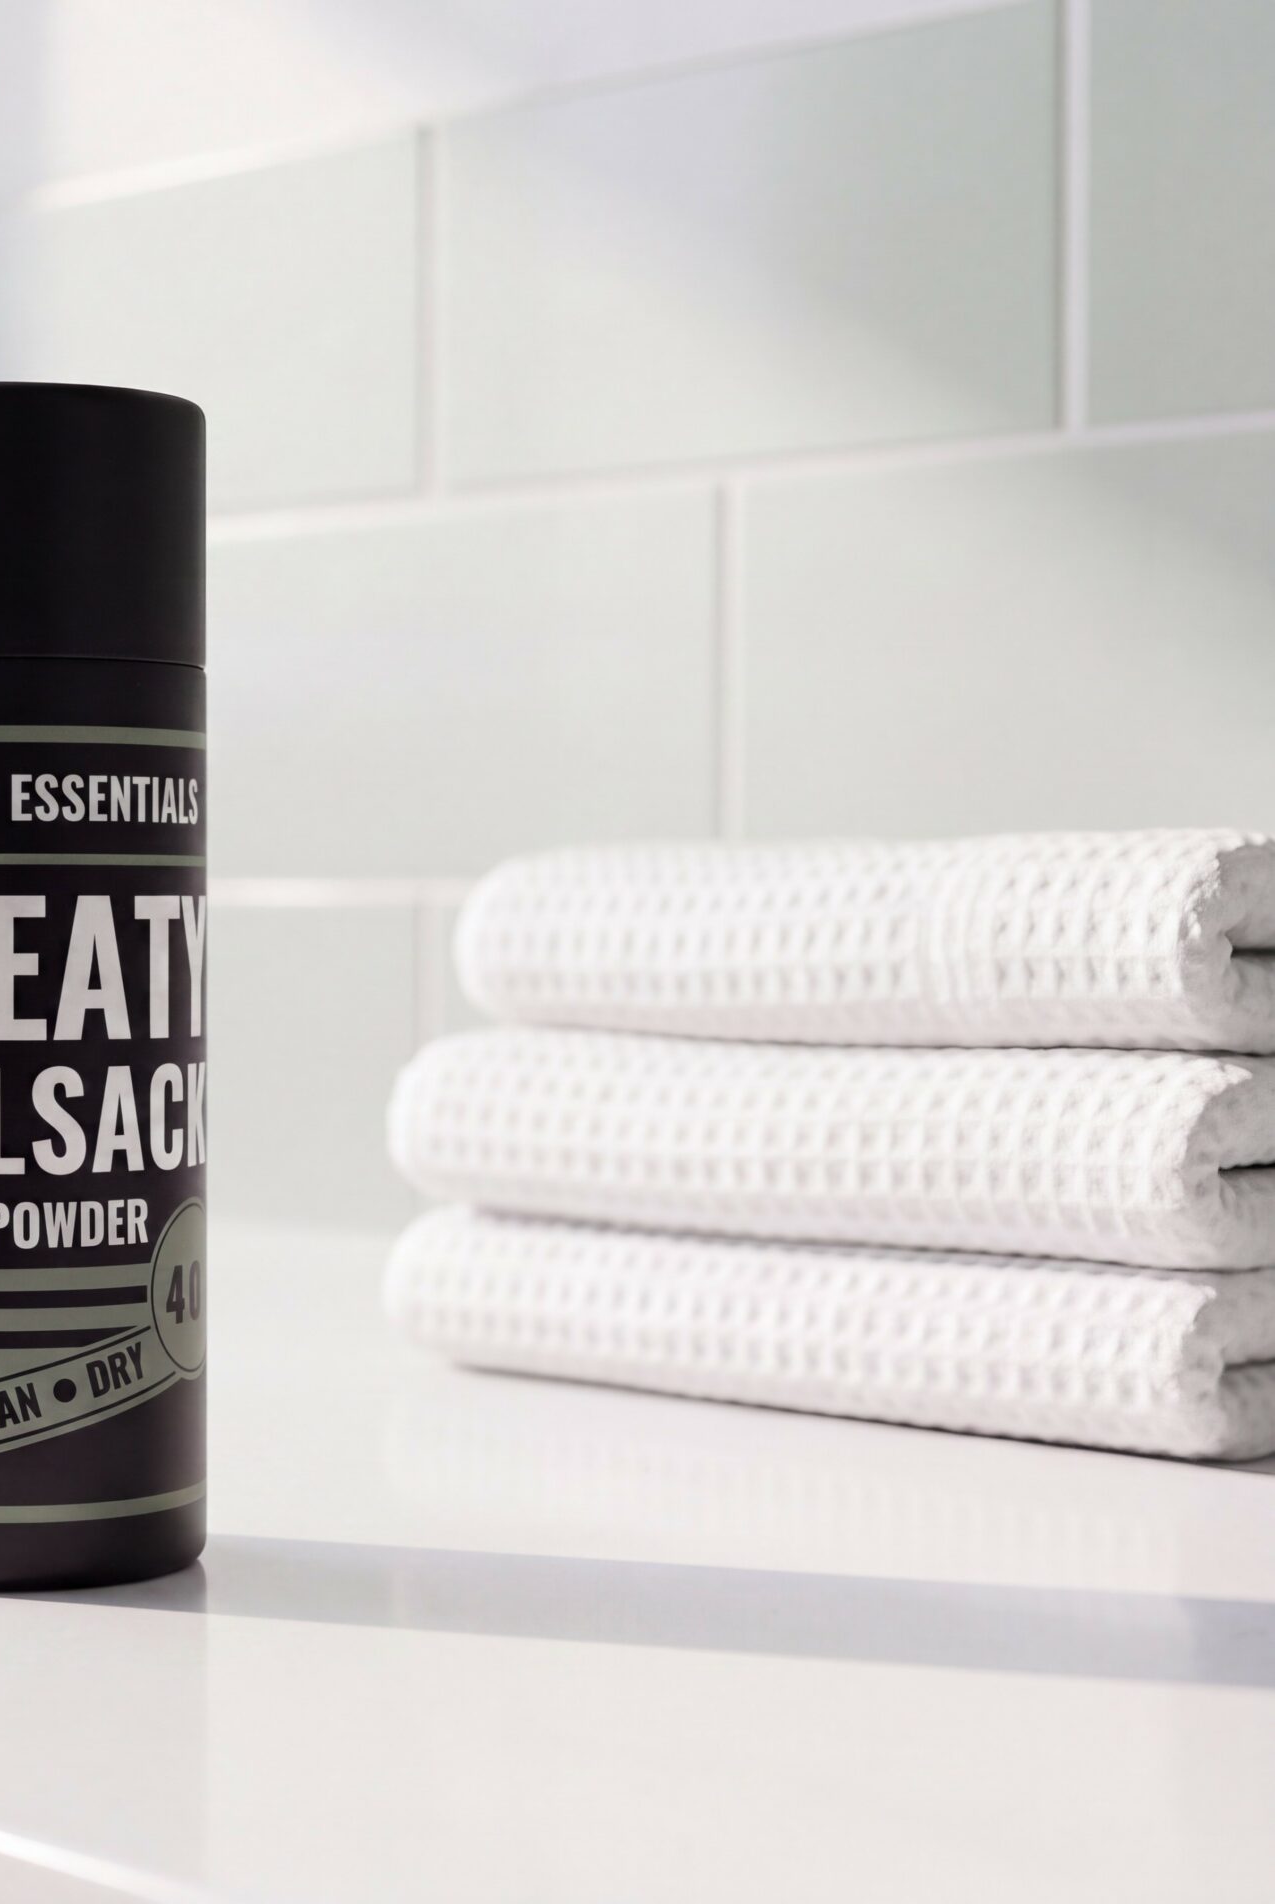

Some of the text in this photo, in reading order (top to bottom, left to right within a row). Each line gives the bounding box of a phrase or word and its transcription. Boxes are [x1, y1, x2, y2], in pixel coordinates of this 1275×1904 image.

[11, 773, 199, 826] ESSENTIALS
[166, 1260, 201, 1325] 40
[86, 1341, 144, 1398] DRY
